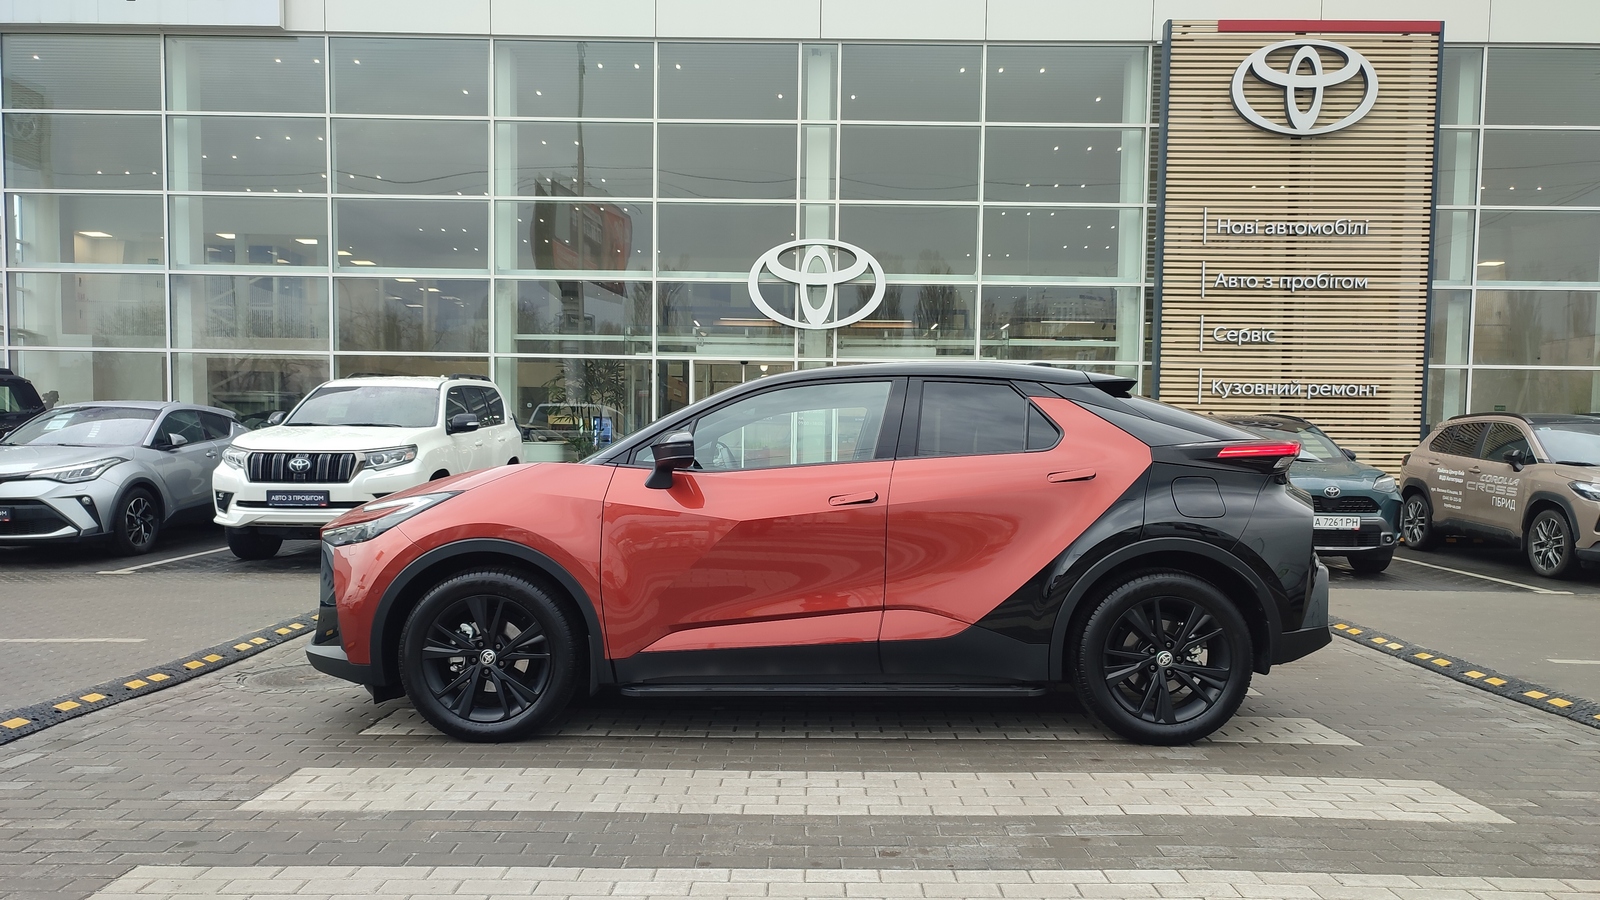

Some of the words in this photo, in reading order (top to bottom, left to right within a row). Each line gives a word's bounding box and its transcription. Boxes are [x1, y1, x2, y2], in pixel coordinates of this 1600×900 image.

[1217, 218, 1259, 235] Нові
[1264, 218, 1370, 235] автомобілі
[1213, 273, 1259, 289] Авто
[1263, 276, 1273, 289] з
[1279, 272, 1369, 292] пробігом
[1213, 326, 1277, 346] Сервіс
[1211, 379, 1302, 398] Кузовний
[1307, 382, 1379, 399] ремонт
[1480, 474, 1520, 486] COROLLA
[1466, 481, 1518, 496] CROSS
[1492, 496, 1516, 512] ГІБРИД
[1324, 518, 1343, 527] 7261
